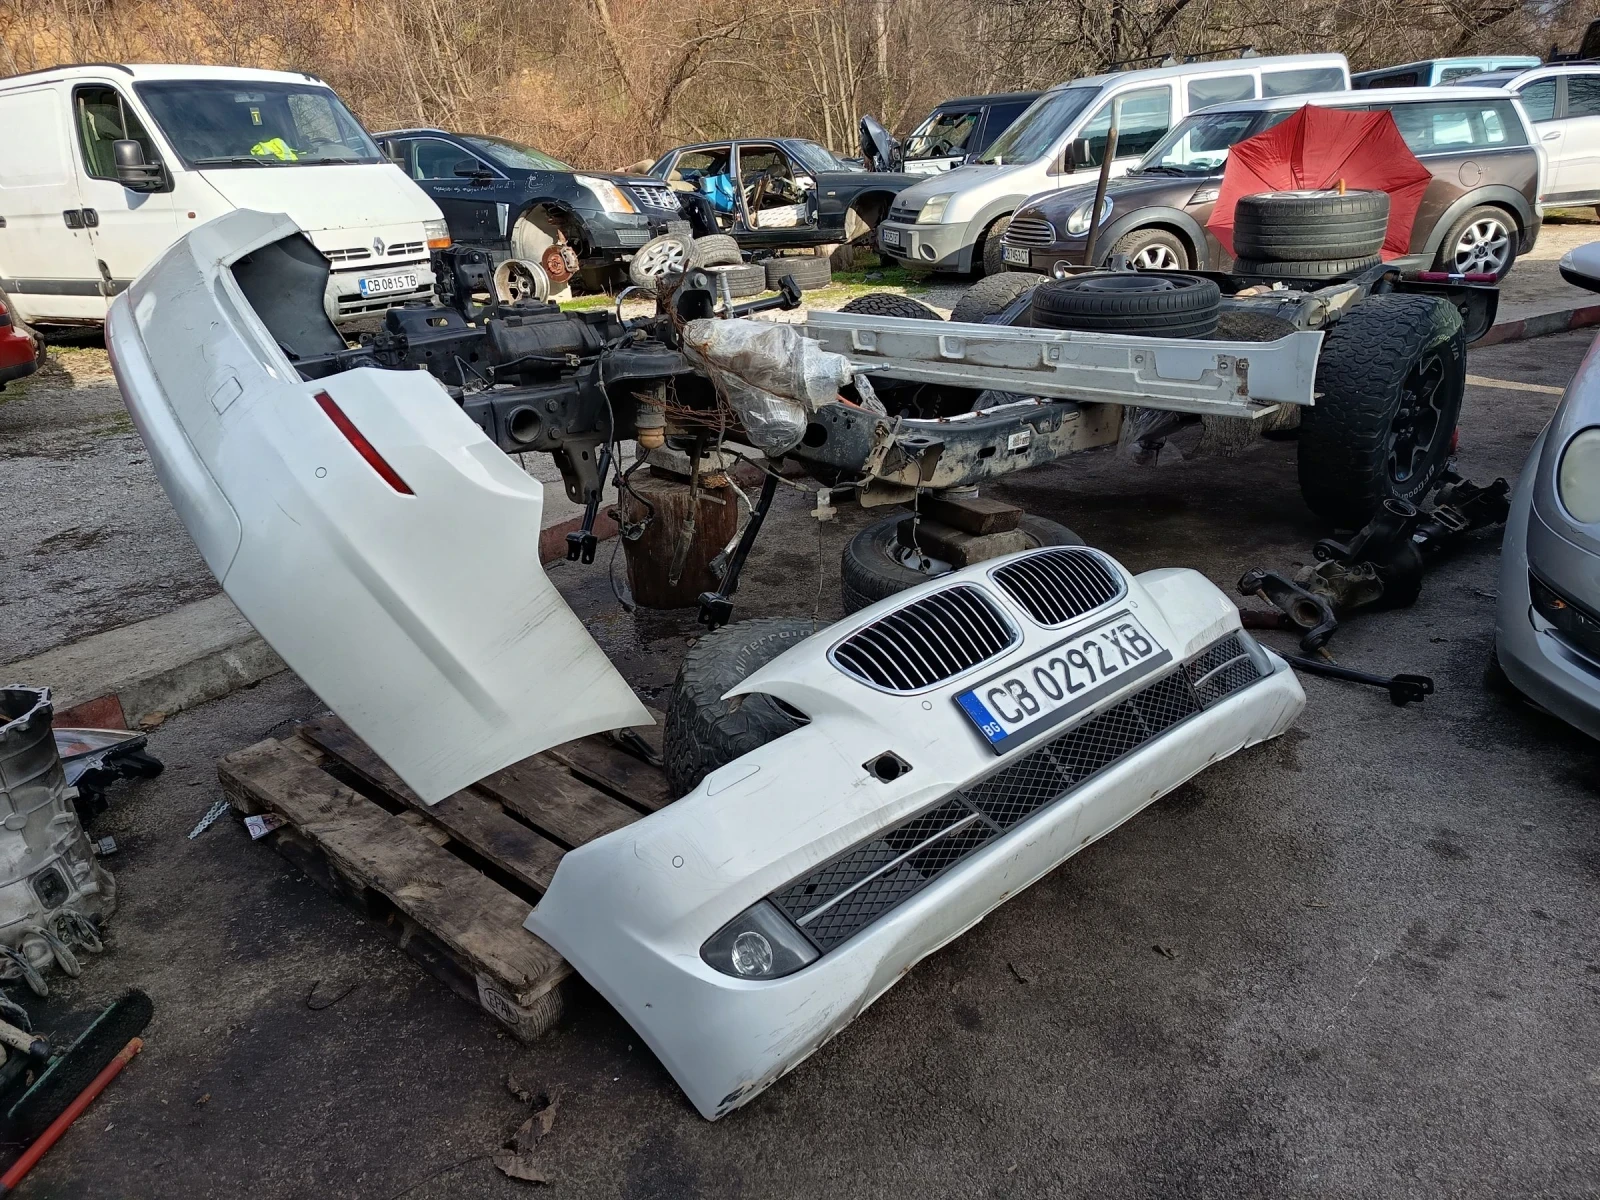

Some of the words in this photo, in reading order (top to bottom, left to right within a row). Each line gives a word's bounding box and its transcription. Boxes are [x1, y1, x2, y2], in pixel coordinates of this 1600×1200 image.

[367, 279, 381, 292] CB
[382, 276, 404, 290] 0815
[404, 275, 417, 287] TB
[987, 678, 1041, 724] CB
[1032, 640, 1119, 701] 0292
[1100, 623, 1153, 666] XB
[982, 721, 1001, 737] BG
